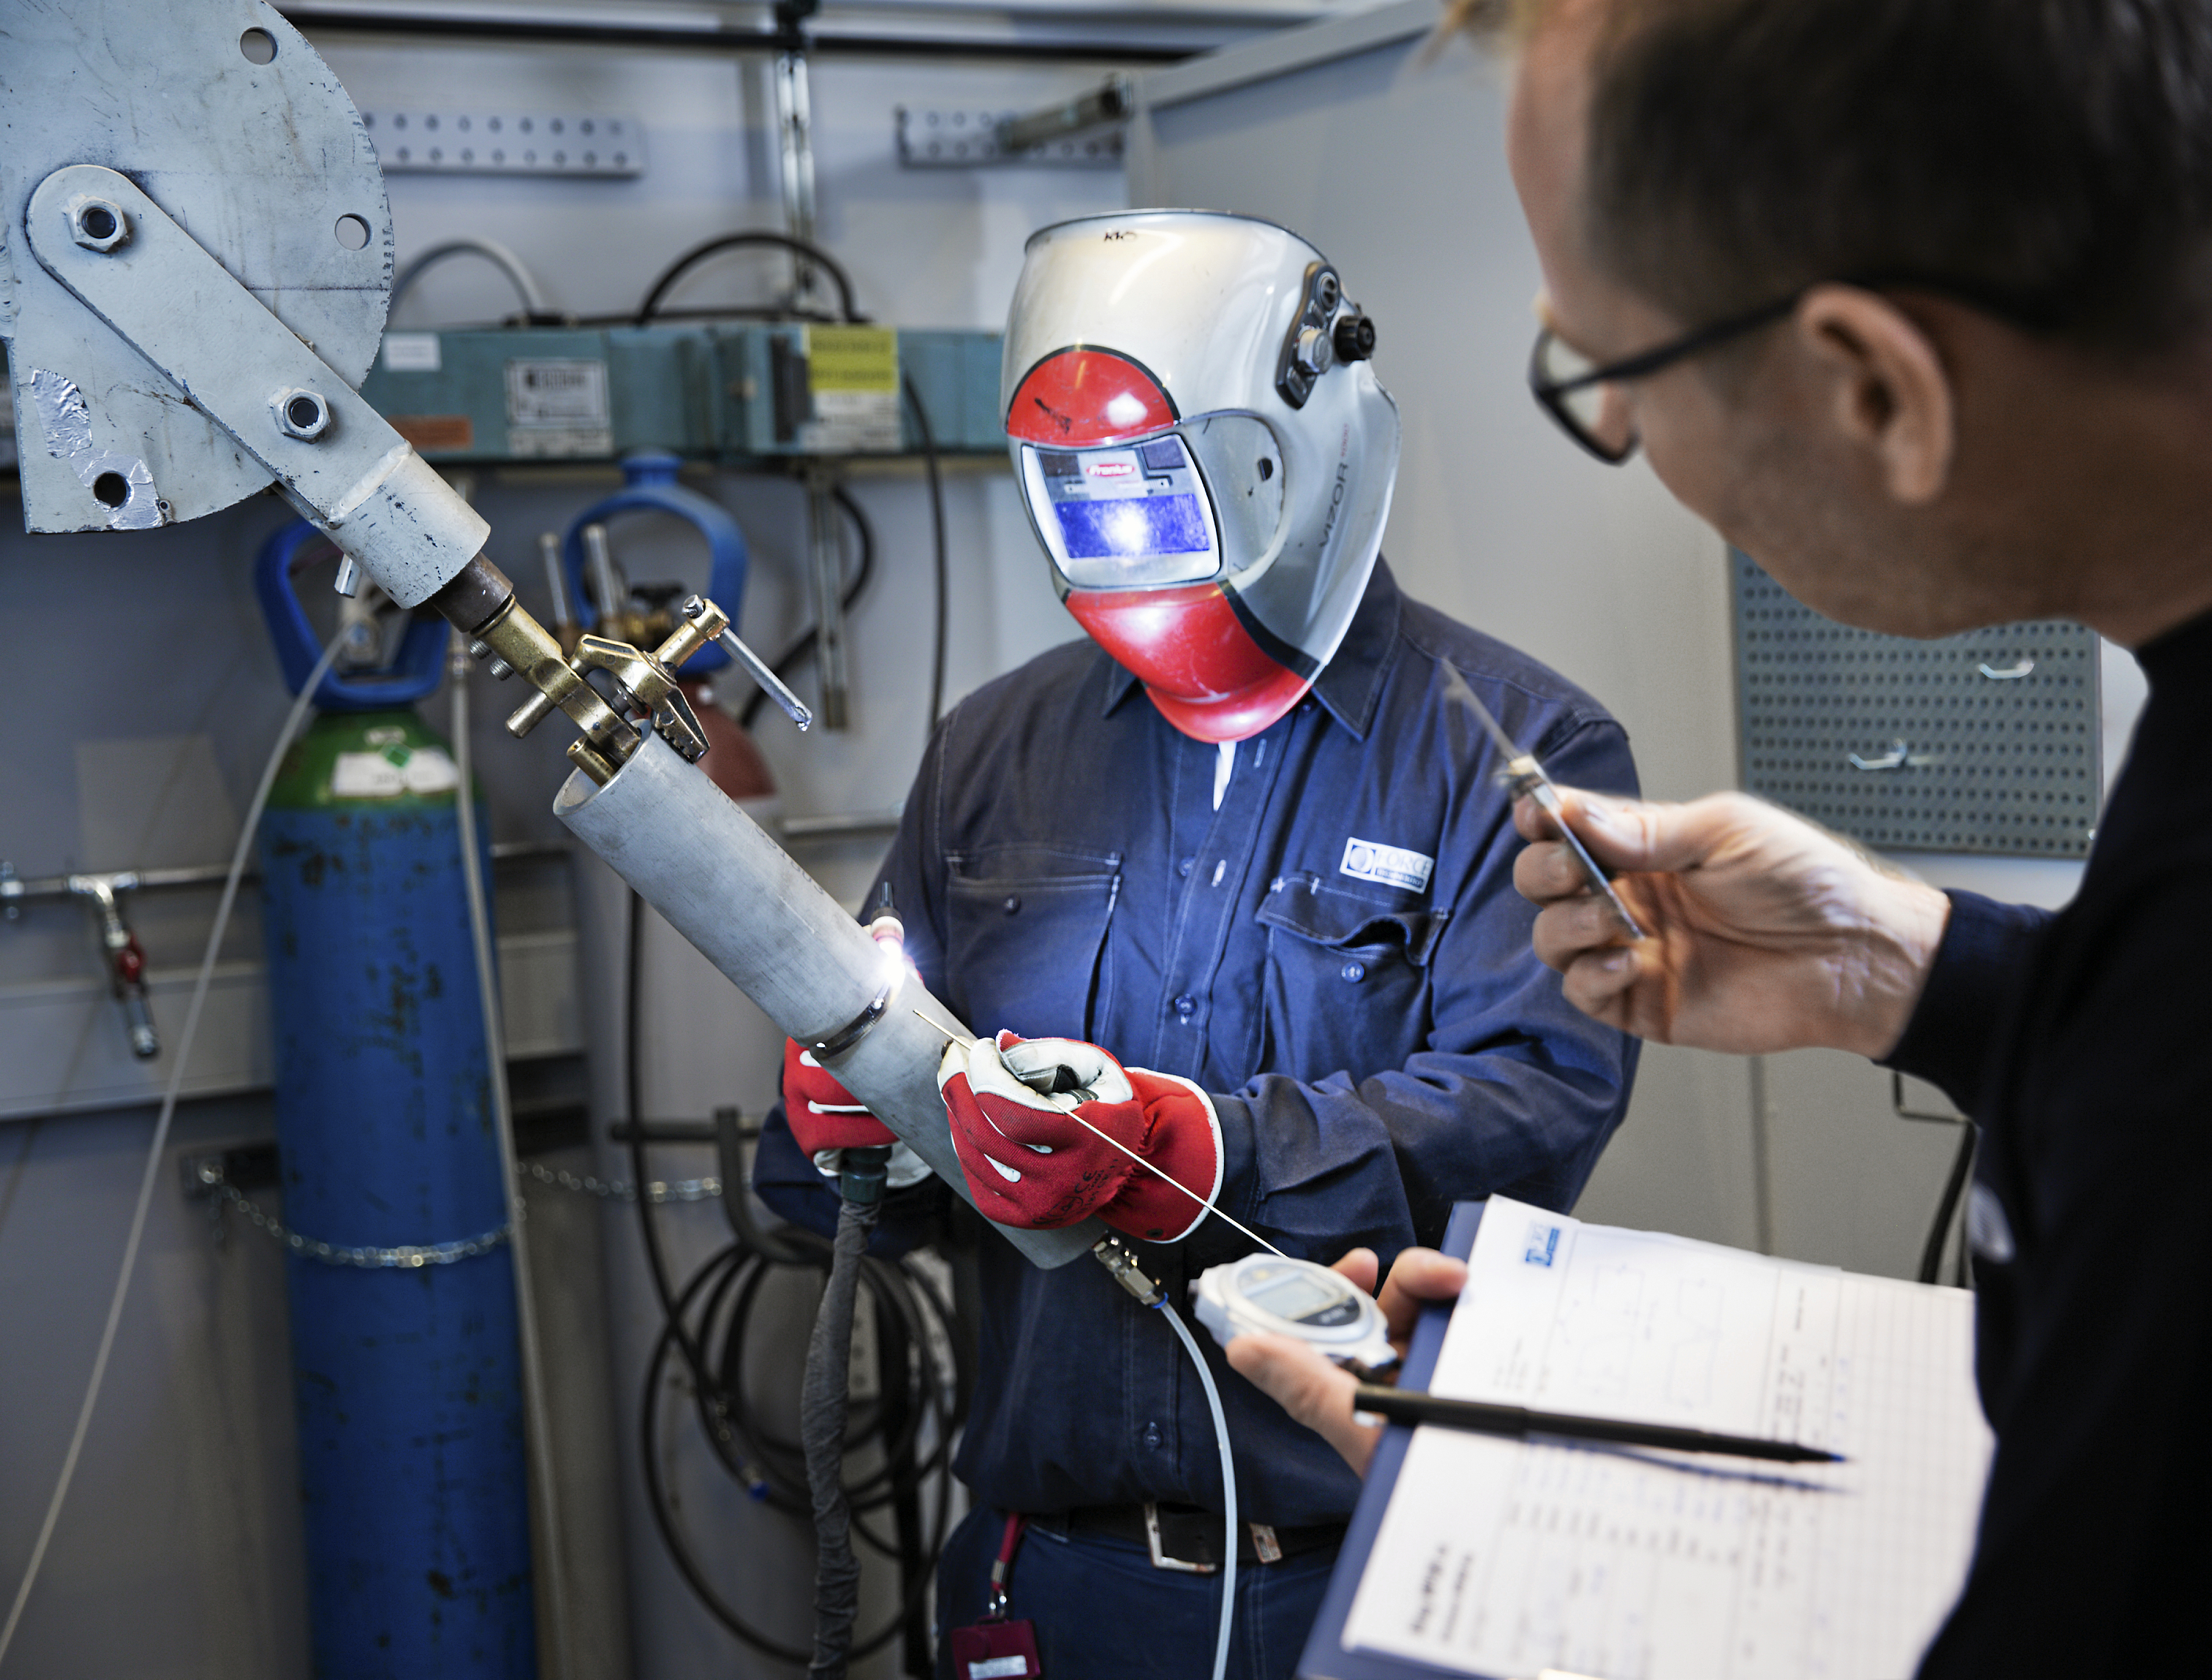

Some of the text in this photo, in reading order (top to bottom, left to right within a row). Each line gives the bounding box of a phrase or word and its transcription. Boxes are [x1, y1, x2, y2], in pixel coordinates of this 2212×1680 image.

[1089, 464, 1133, 476] Fronius
[1318, 462, 1349, 547] VIZOR
[1377, 850, 1433, 876] FORCE
